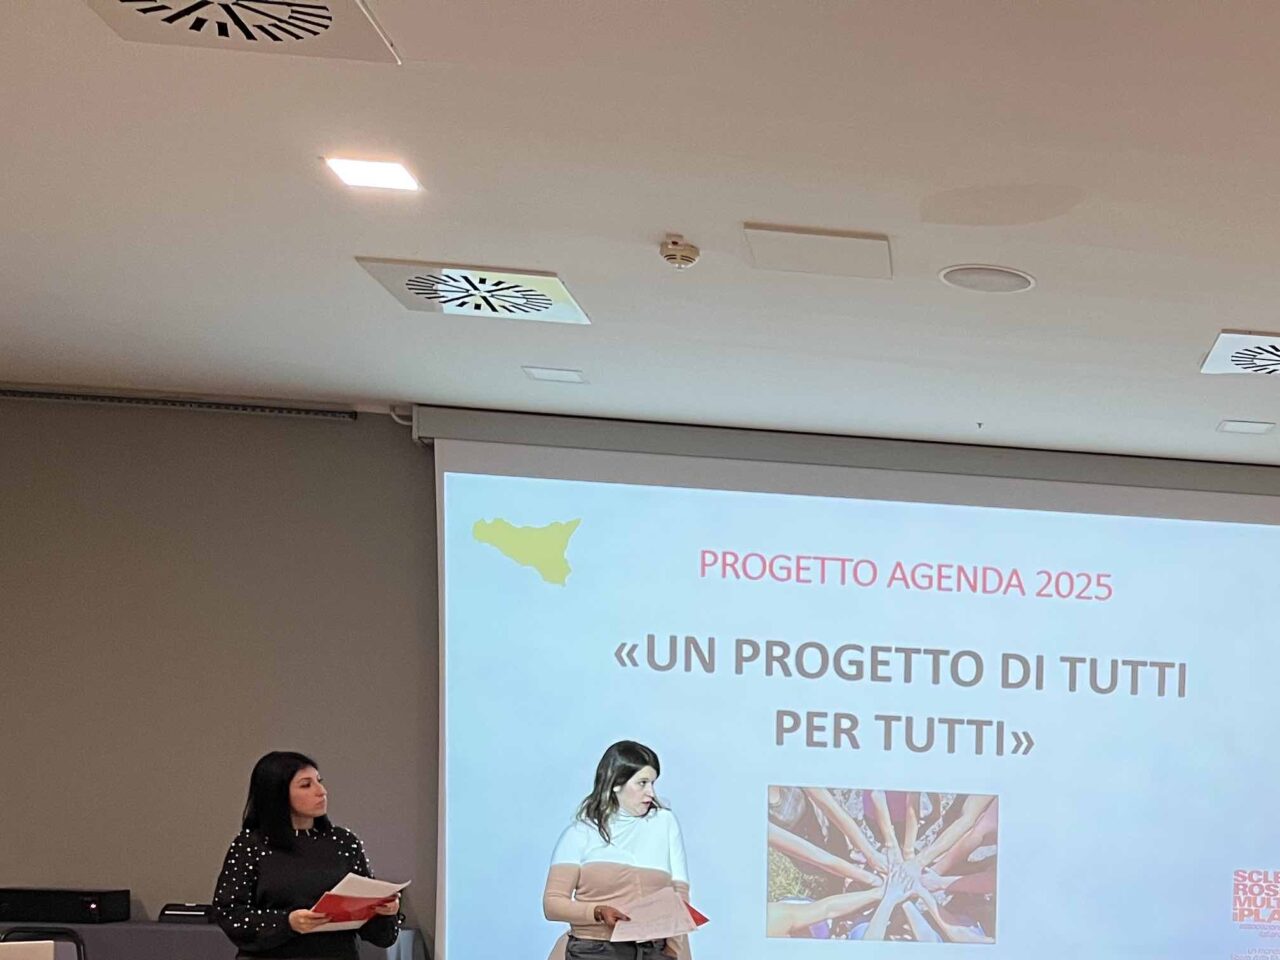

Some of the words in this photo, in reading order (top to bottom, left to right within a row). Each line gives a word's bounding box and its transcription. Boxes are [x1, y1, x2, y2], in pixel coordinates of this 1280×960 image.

[700, 550, 878, 587] PROGETTO
[887, 561, 1026, 596] AGENDA
[1036, 570, 1113, 601] 2025
[614, 633, 716, 674] «UN
[735, 638, 984, 687] PROGETTO
[1001, 652, 1044, 691] DI
[1059, 656, 1187, 698] TUTTI
[775, 709, 861, 750] PER
[874, 714, 1035, 756] TUTTI»
